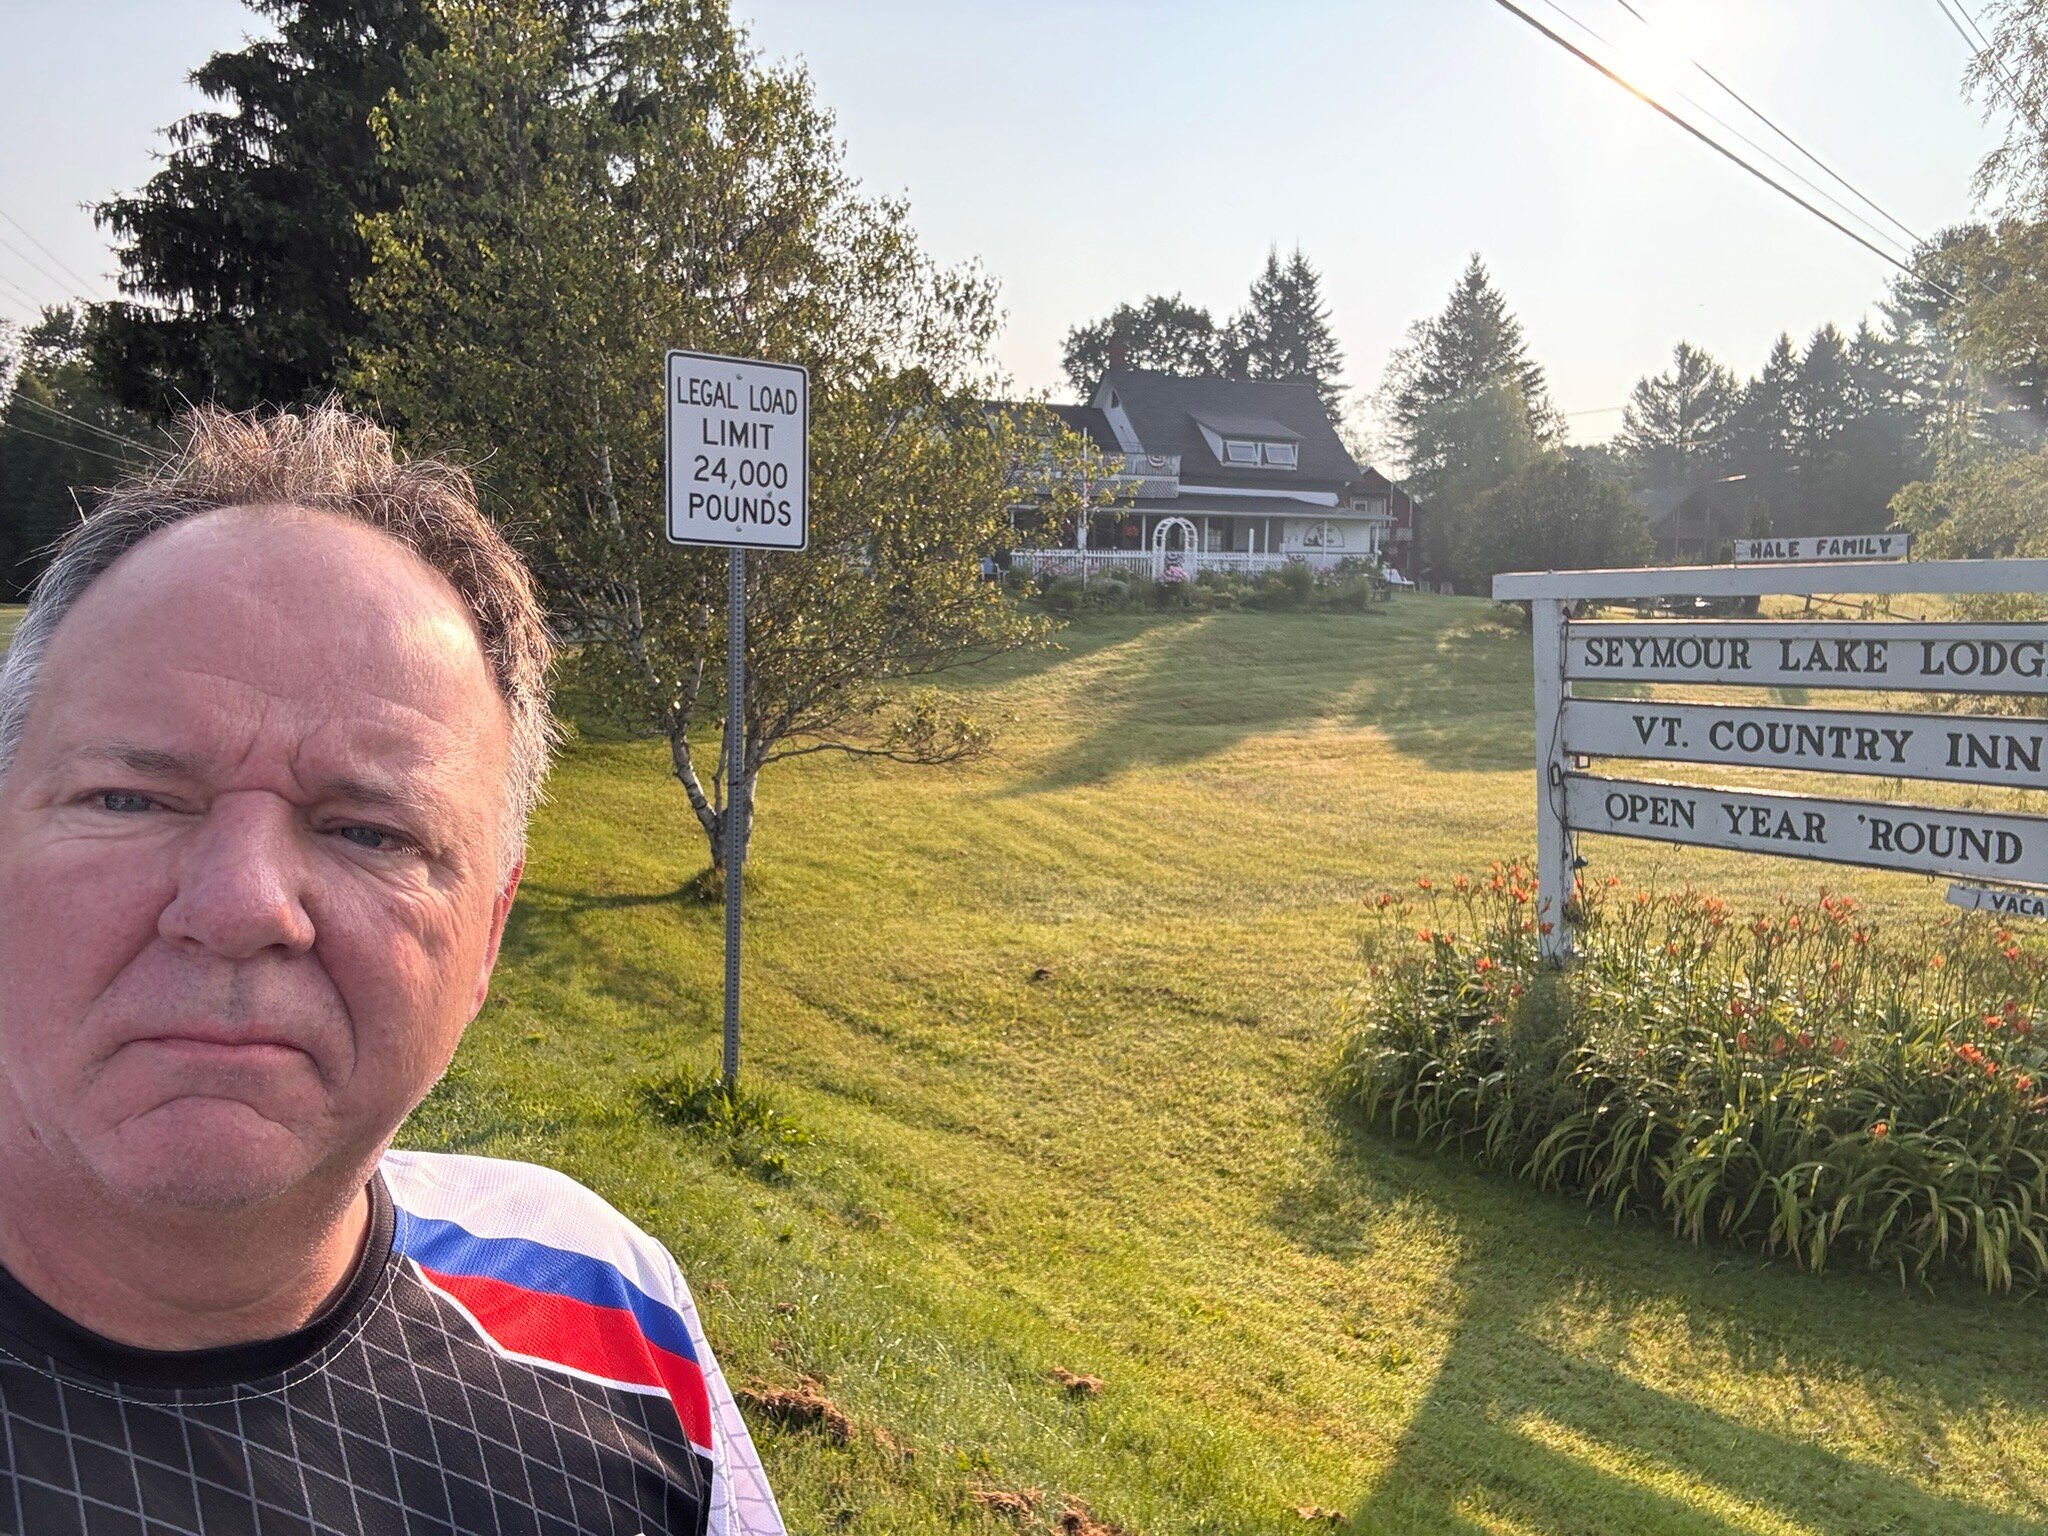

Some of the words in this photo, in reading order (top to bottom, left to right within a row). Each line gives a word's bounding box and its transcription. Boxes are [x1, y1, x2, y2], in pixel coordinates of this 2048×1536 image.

[677, 377, 739, 410] LEGAL
[749, 385, 798, 415] LOAD
[703, 418, 774, 450] LIMIT
[693, 455, 788, 490] 24,000
[689, 492, 792, 527] POUNDS
[1750, 541, 1800, 559] HALE
[1816, 538, 1892, 556] FAMILY
[1585, 637, 1752, 669] SEYMOUR
[1778, 639, 1889, 673] LAKE
[1920, 640, 2048, 678] LODG
[1632, 715, 1689, 748] VT.
[1709, 720, 1914, 763] COUNTRY
[1945, 732, 2044, 772] INN
[1605, 793, 1697, 829] OPEN
[1721, 803, 1828, 844] YEAR
[1857, 814, 2023, 865] 'ROUND
